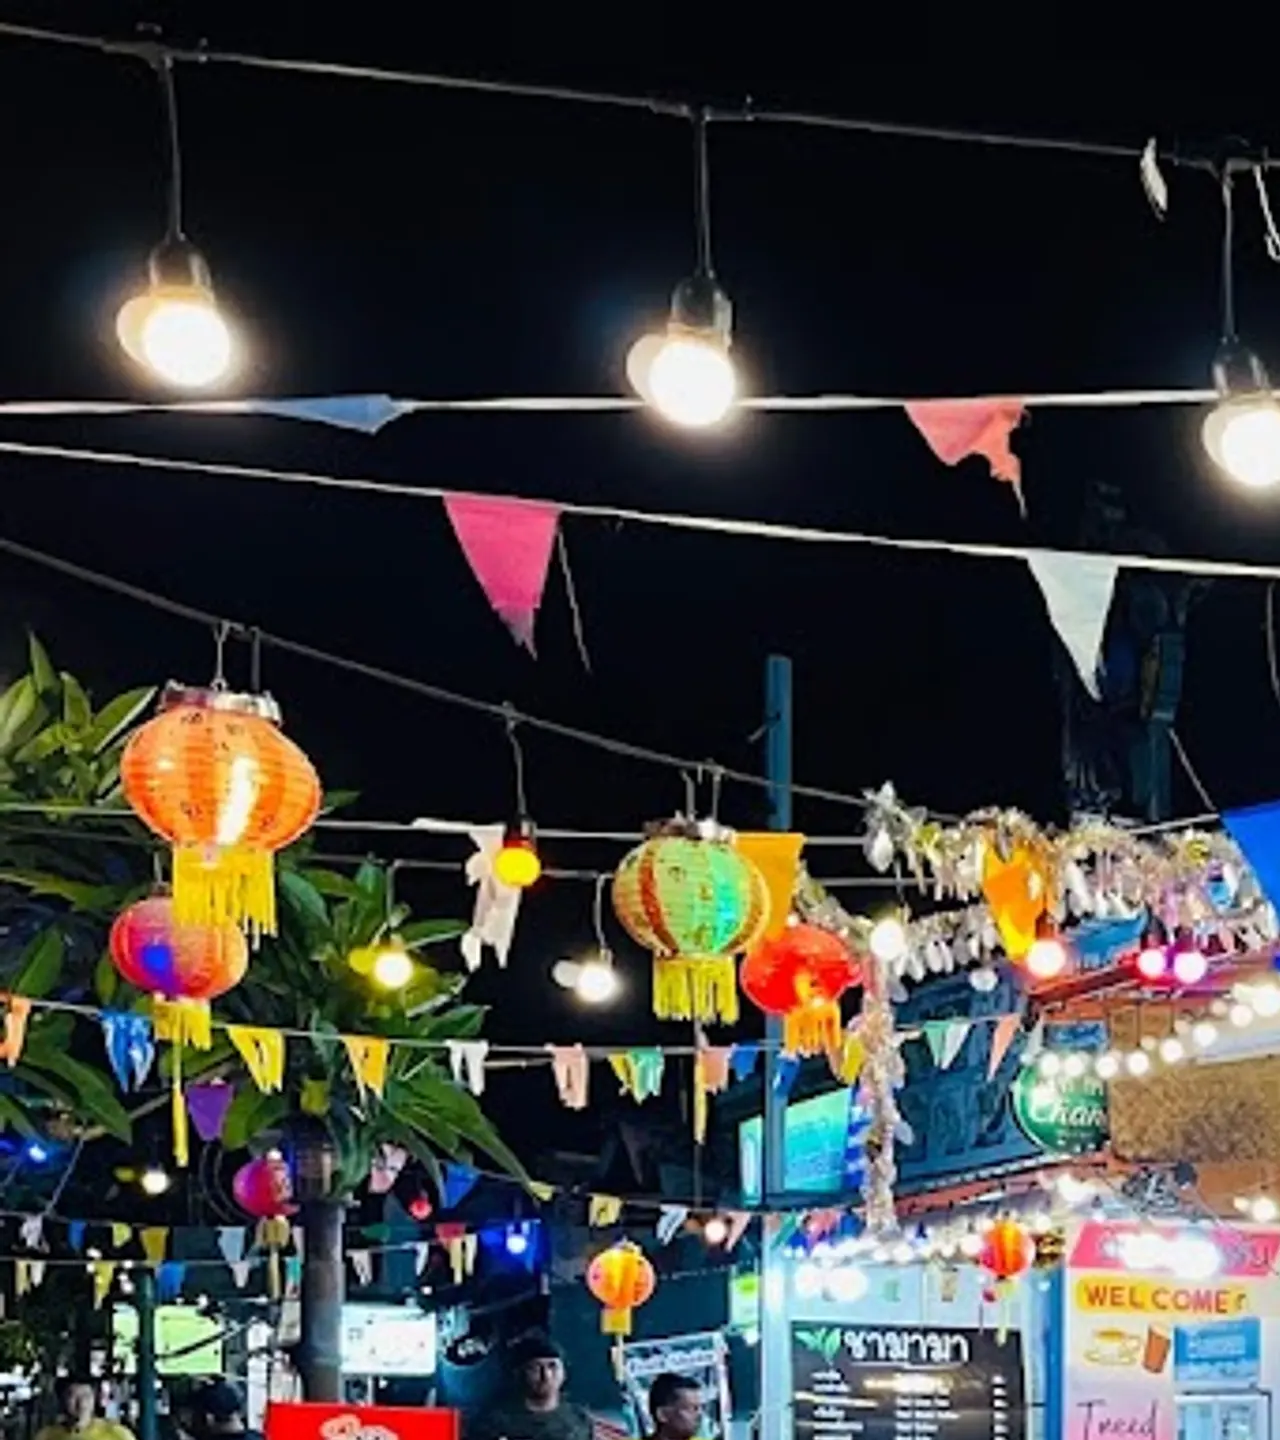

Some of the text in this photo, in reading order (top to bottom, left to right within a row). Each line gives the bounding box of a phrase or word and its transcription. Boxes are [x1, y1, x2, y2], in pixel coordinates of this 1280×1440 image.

[1027, 1088, 1107, 1127] Chan
[844, 1330, 970, 1363] ชามามา
